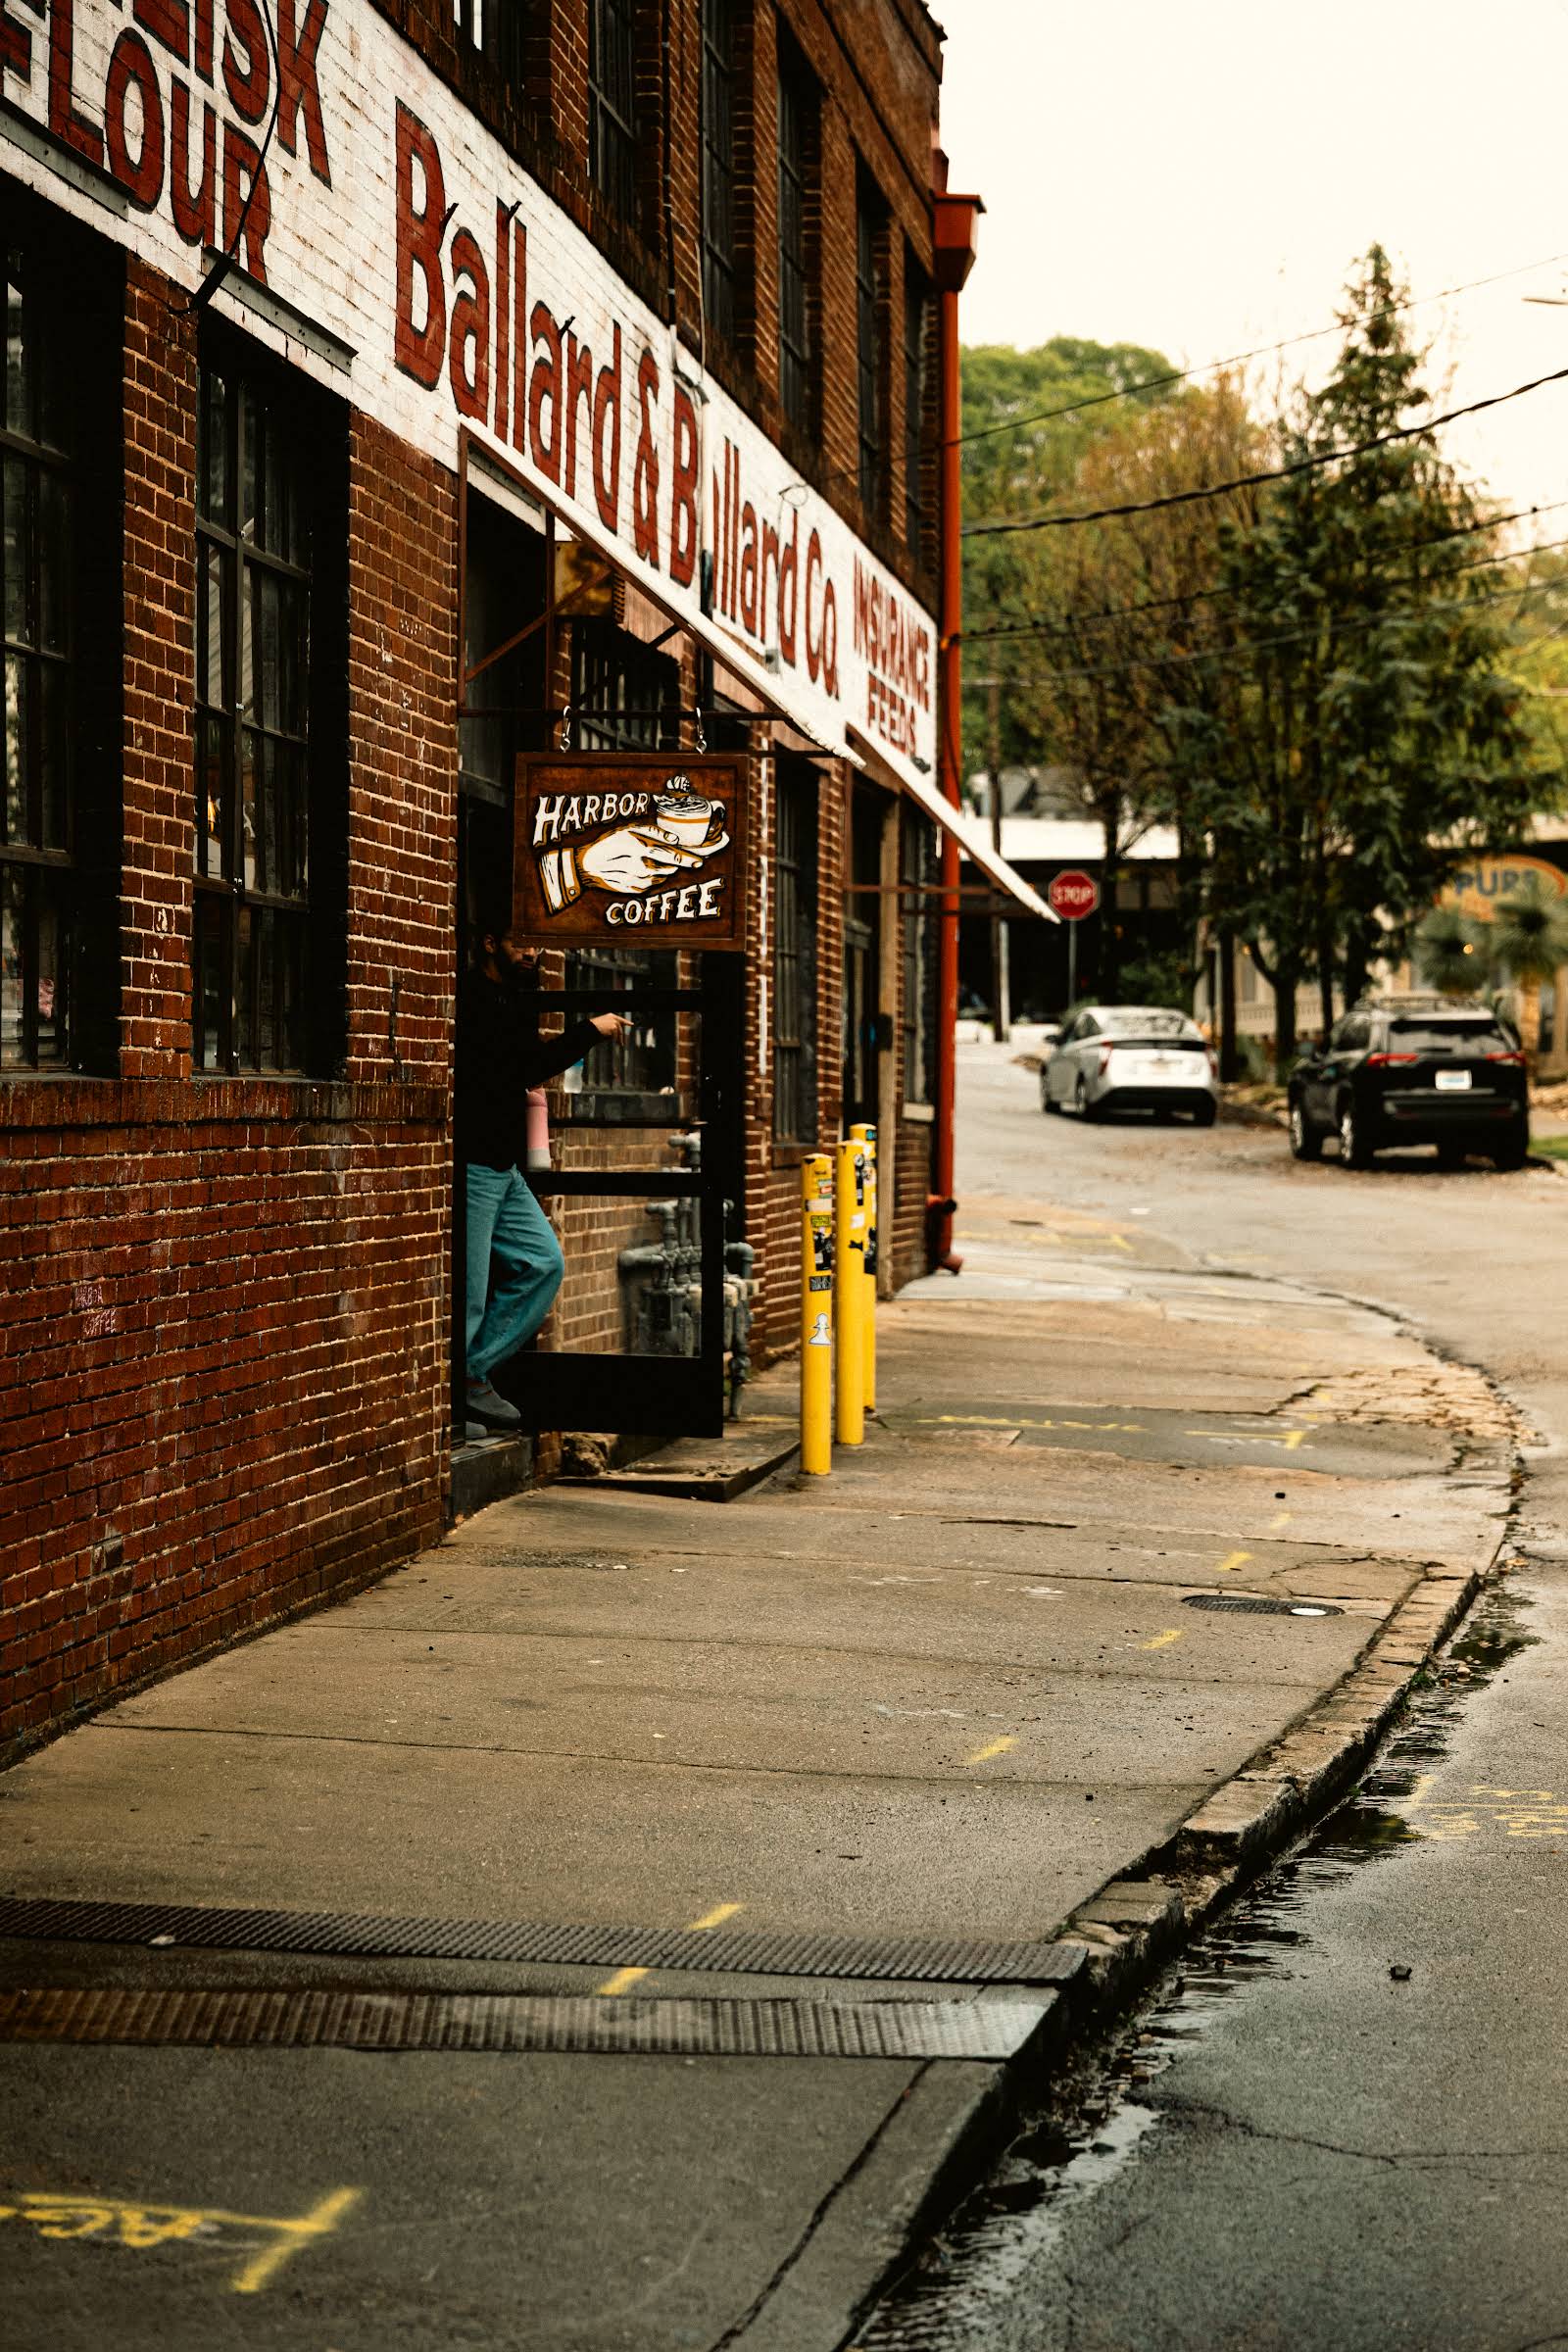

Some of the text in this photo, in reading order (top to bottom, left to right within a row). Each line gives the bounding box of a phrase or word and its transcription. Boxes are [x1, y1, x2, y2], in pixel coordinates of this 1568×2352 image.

[395, 96, 622, 536] Ballard
[634, 346, 660, 571] &
[854, 551, 930, 714] INSURANCE
[866, 670, 916, 758] FEEDS
[533, 792, 651, 847] HARBOR
[605, 877, 725, 925] COFFEE
[1052, 885, 1093, 905] STOP
